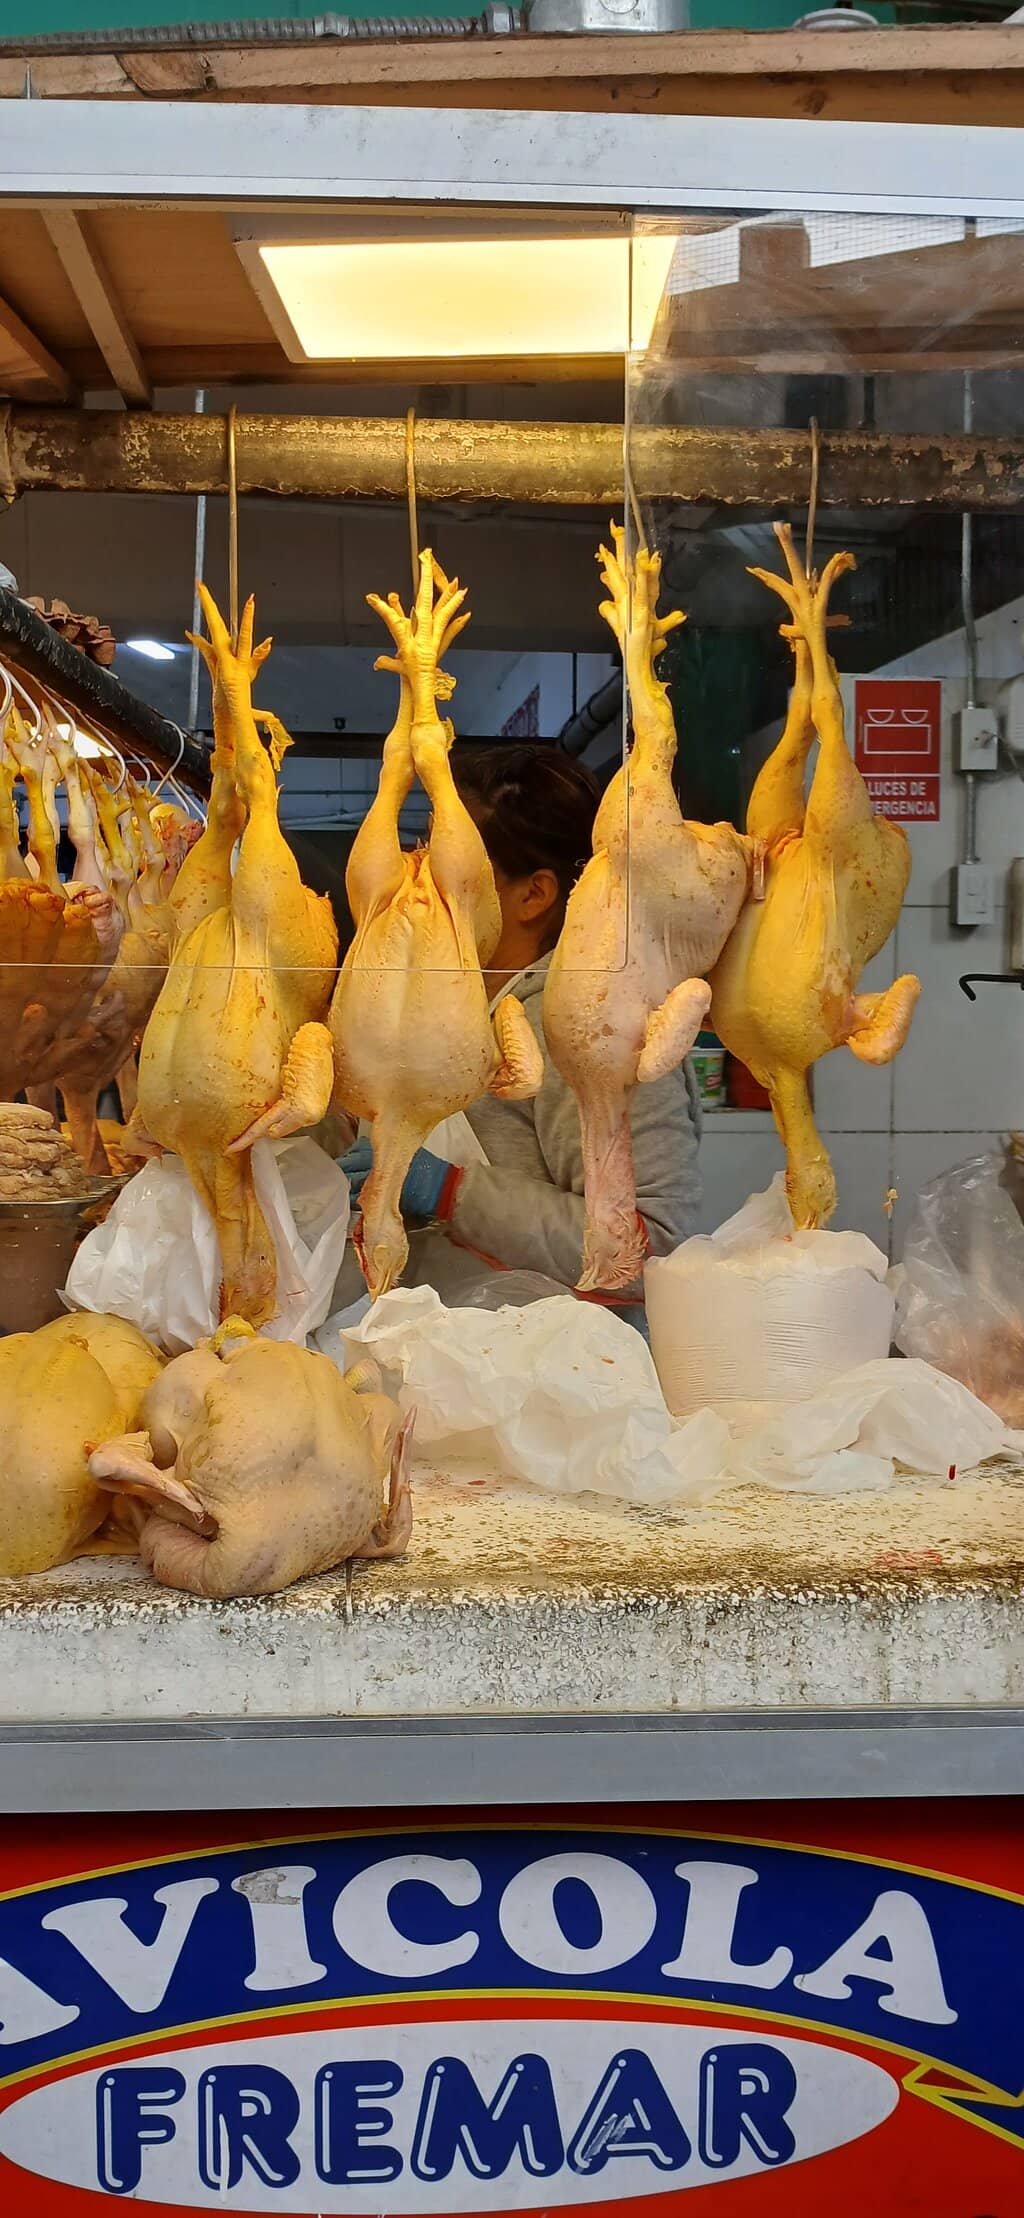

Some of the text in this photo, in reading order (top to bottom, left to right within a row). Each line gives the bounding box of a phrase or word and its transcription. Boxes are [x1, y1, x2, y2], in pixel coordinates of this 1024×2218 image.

[868, 781, 926, 796] LUCES DE
[872, 800, 936, 815] ERGENCIA
[96, 2043, 797, 2195] FREMAR
